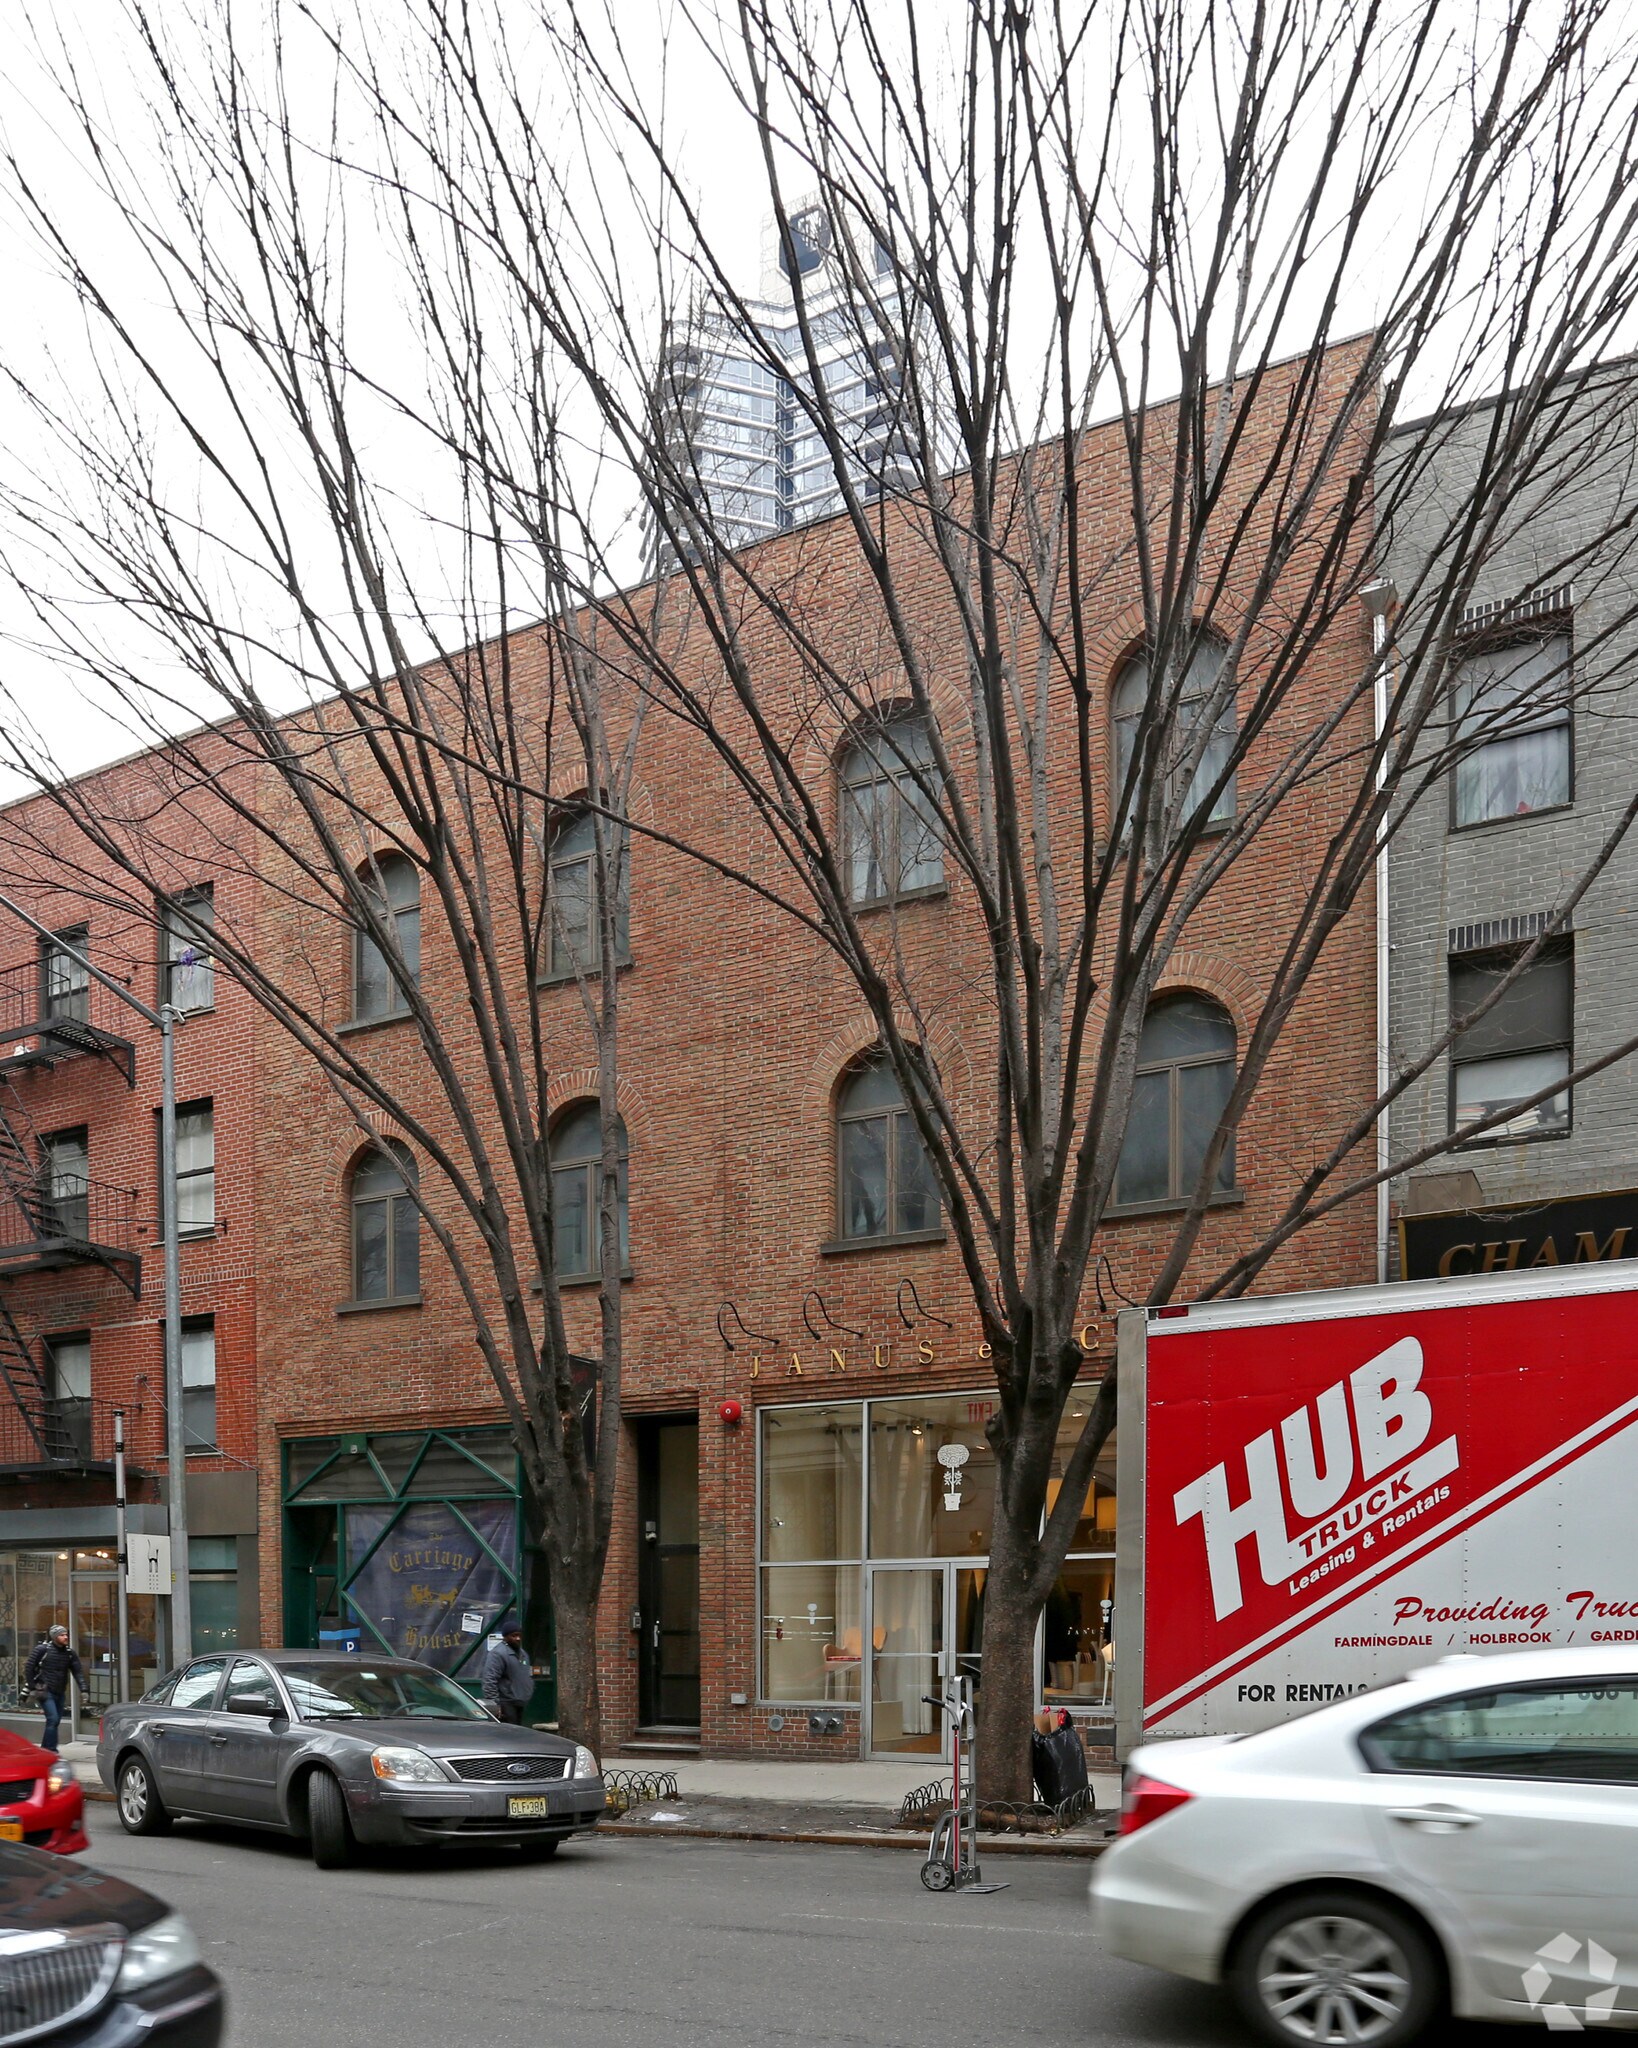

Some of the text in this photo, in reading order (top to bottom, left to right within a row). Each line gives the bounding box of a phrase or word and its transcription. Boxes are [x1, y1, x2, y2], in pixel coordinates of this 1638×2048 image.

[750, 1339, 934, 1379] JANUS
[1173, 1336, 1432, 1622] HUB
[1299, 1471, 1414, 1558] TRUCK
[1289, 1485, 1451, 1597] Leasing & Rentals
[389, 1546, 473, 1573] Carriage
[1393, 1596, 1551, 1629] Providing
[405, 1625, 461, 1649] House
[1334, 1635, 1433, 1648] FARMINGDALE
[1469, 1631, 1552, 1645] HOLBROOK
[1238, 1685, 1275, 1702] FOR
